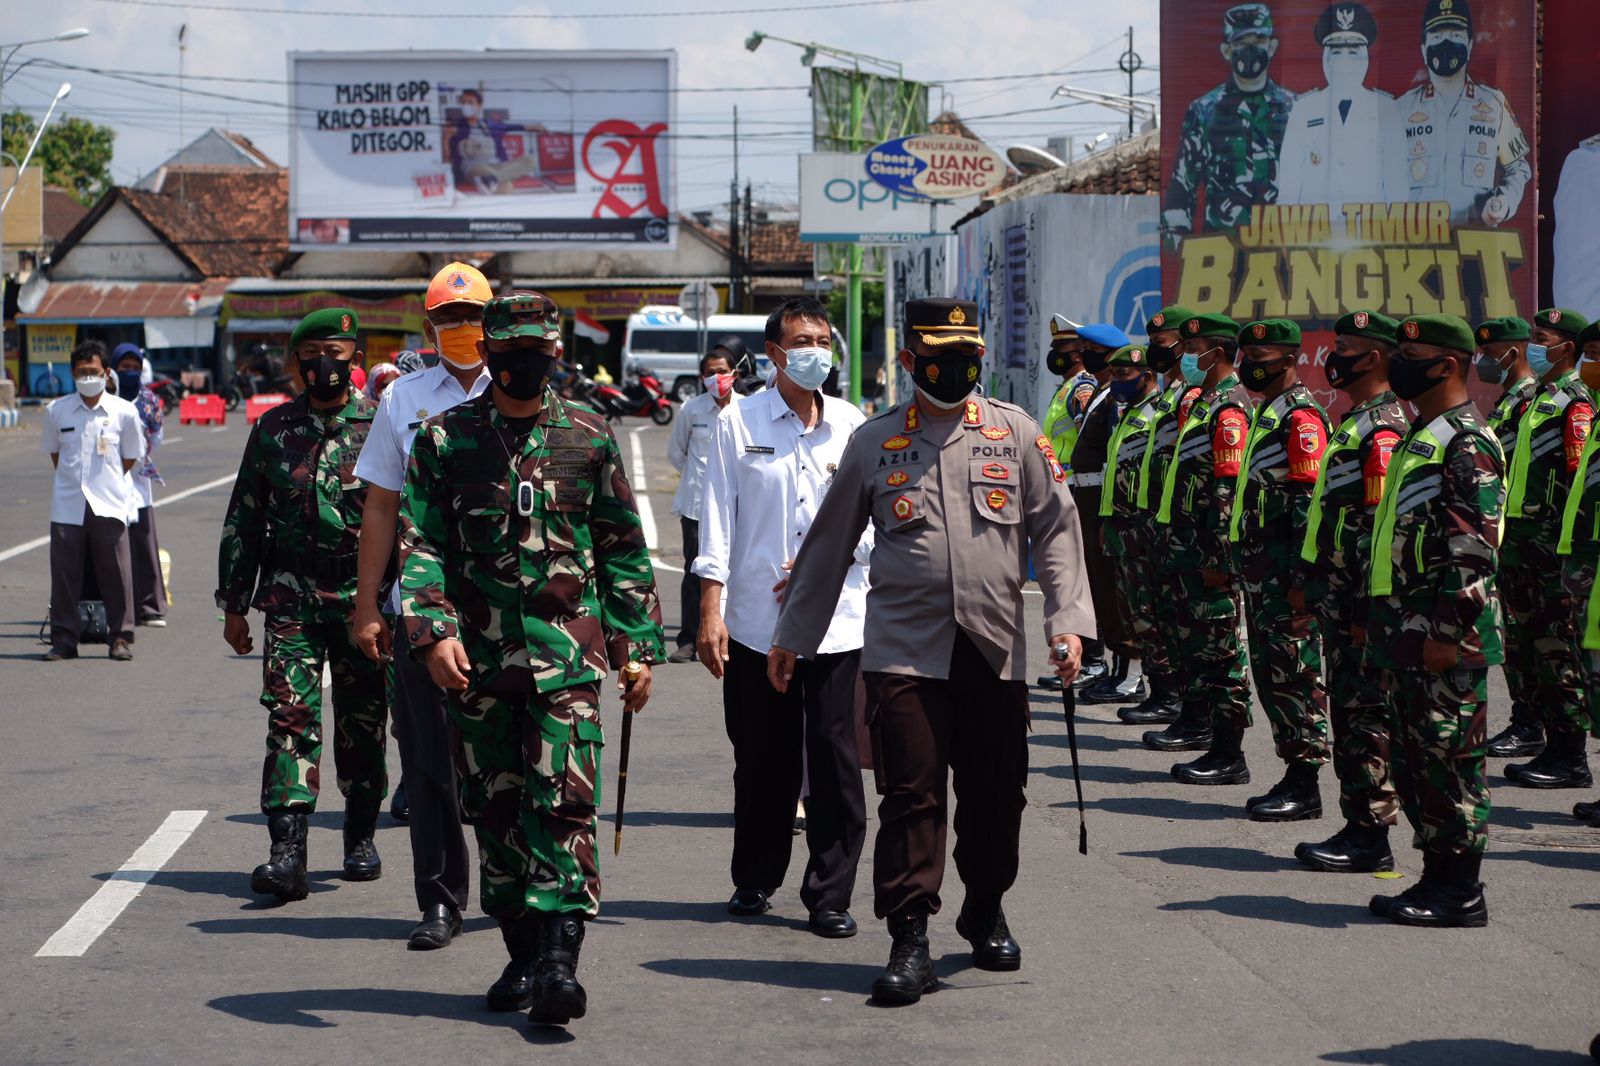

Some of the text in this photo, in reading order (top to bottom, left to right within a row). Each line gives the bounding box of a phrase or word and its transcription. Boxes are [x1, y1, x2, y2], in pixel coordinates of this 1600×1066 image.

[335, 80, 430, 104] MASIH GPP
[317, 105, 431, 131] KALO BELOM
[1405, 124, 1433, 139] NICO
[1468, 124, 1496, 138] POLRI
[351, 131, 432, 154] DITEGOR.
[907, 141, 980, 152] PENUKARAN
[871, 151, 915, 167] Money
[930, 154, 995, 173] UANG
[870, 163, 918, 178] Changer
[925, 170, 986, 188] ASING
[824, 178, 936, 211] opp
[1239, 201, 1451, 247] JAWA TIMUR
[1174, 228, 1525, 320] BANGKIT
[878, 452, 919, 468] AZIS
[971, 446, 1018, 458] POLRI
[1213, 448, 1245, 464] BABIN
[1291, 459, 1321, 475] BABIN
